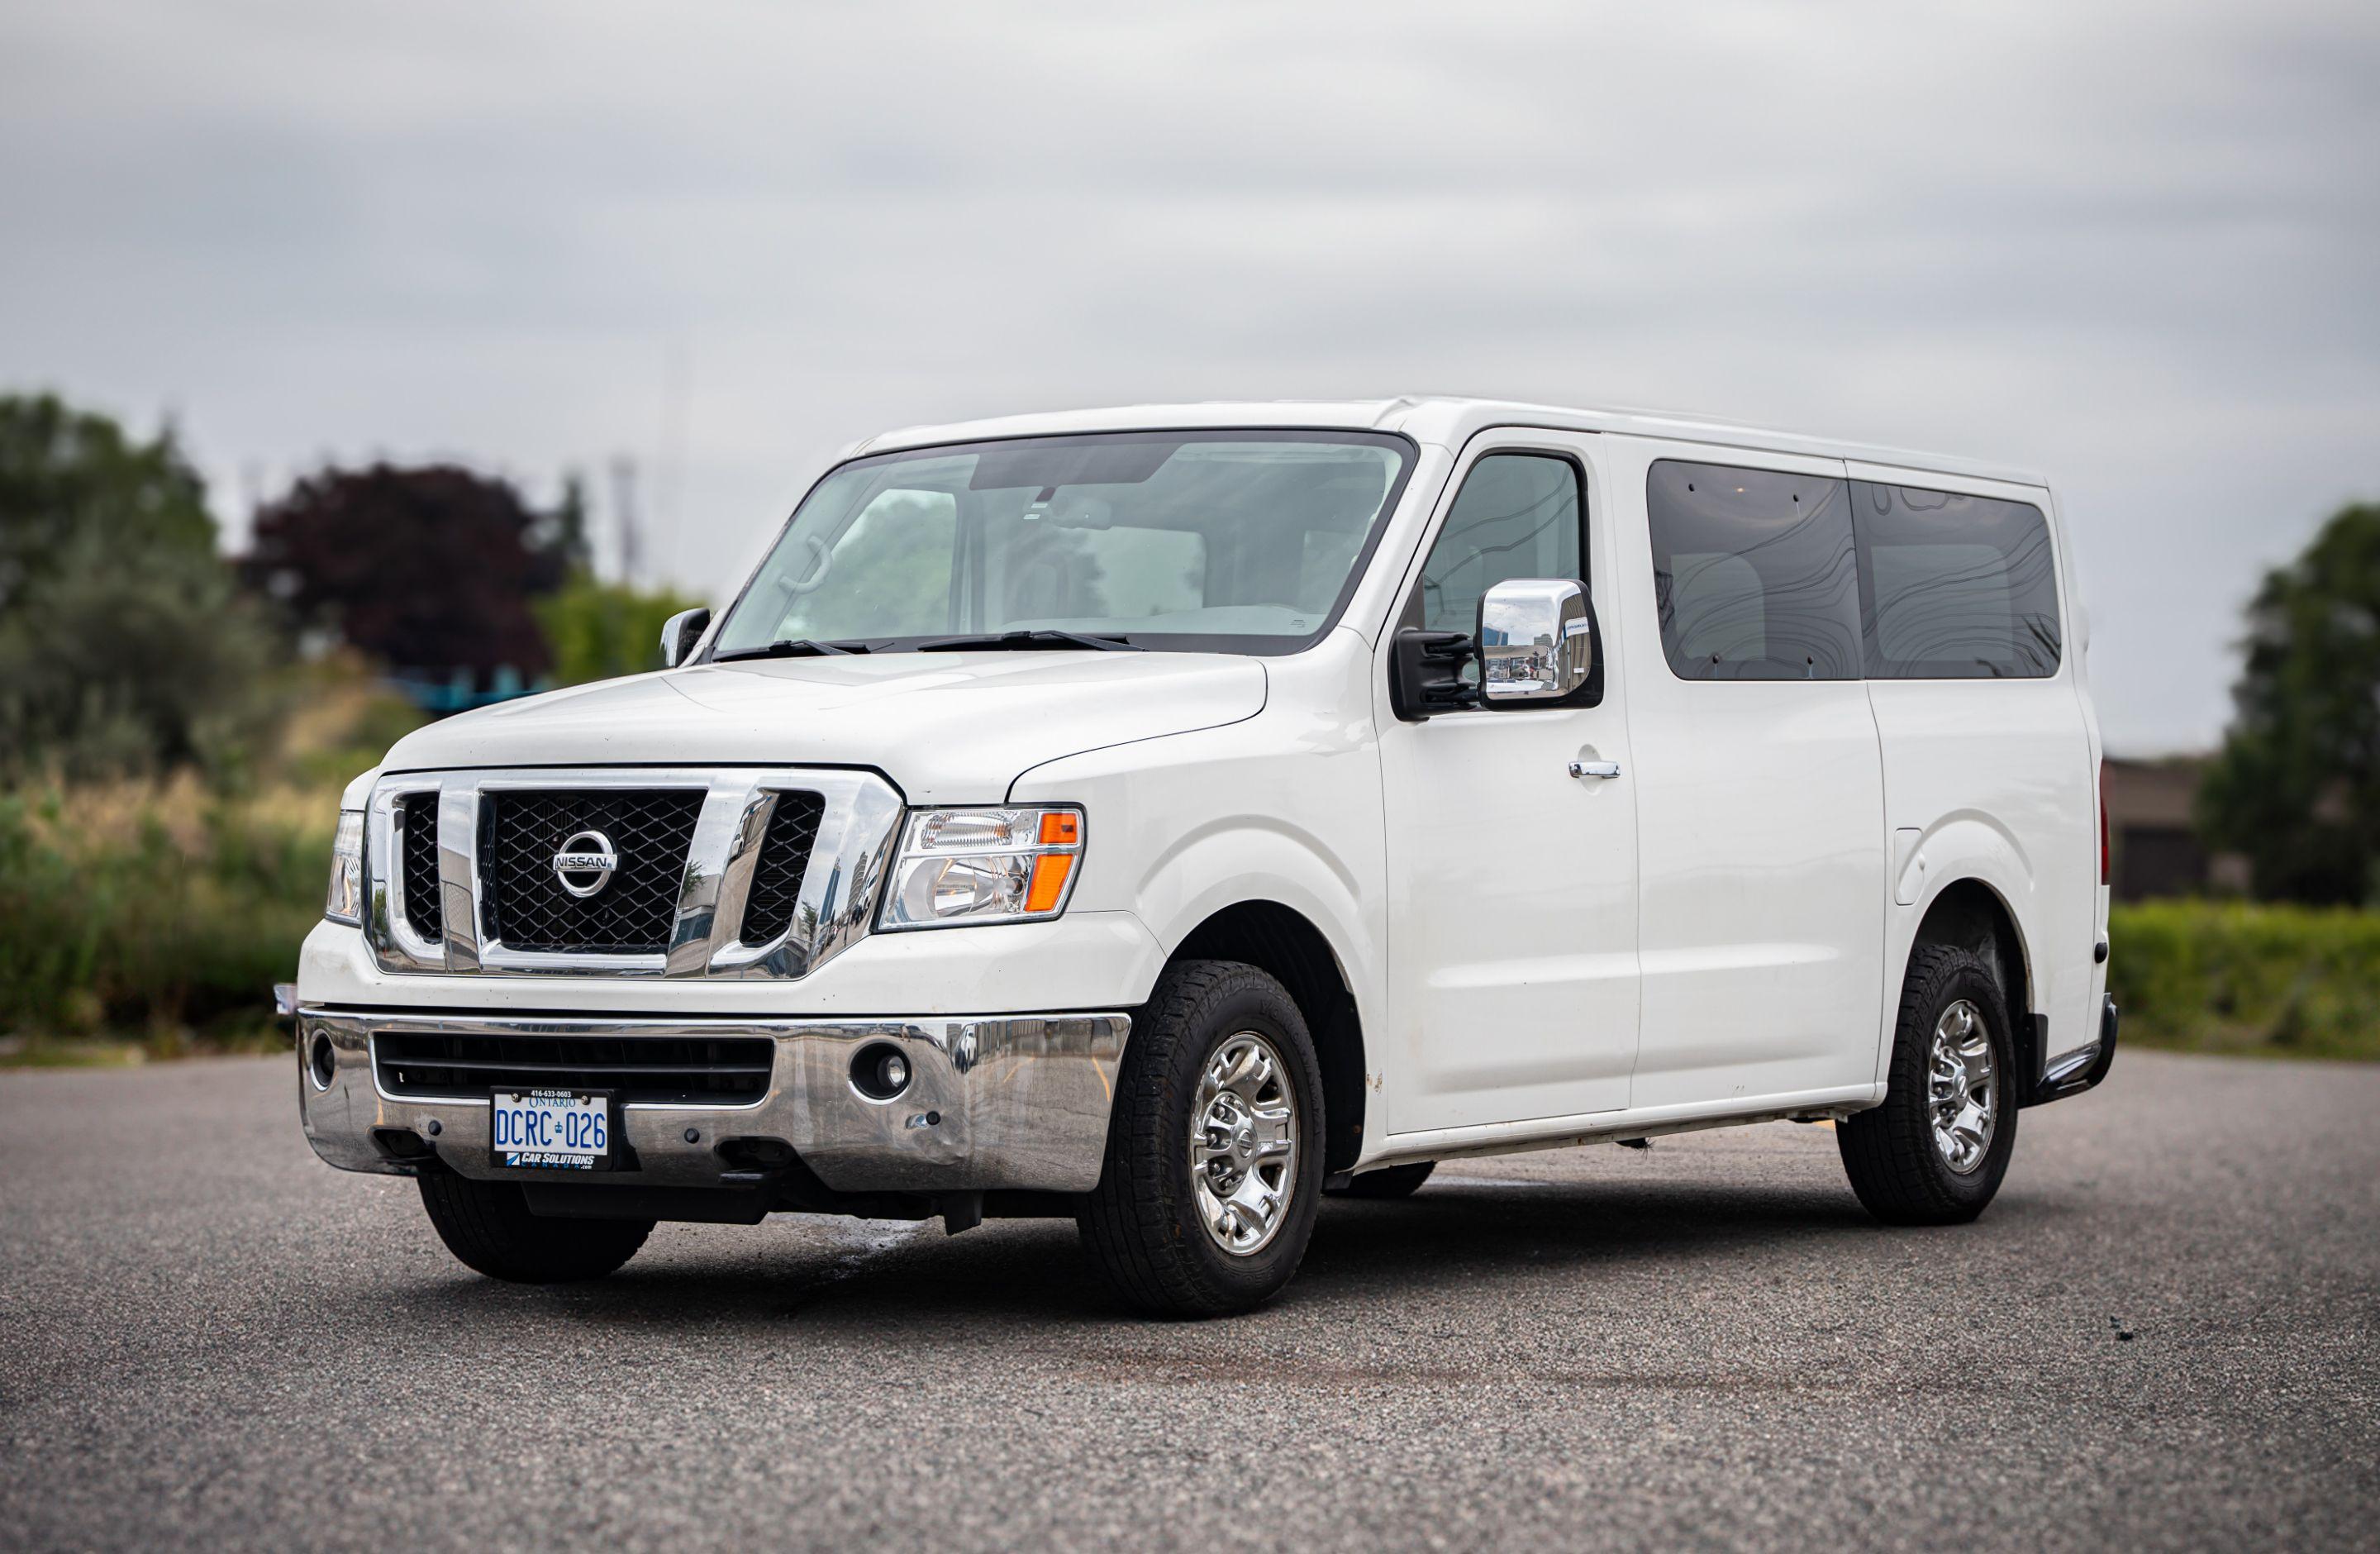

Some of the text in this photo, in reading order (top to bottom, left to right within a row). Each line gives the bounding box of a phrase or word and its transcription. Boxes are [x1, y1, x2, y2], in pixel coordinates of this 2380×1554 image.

[555, 856, 607, 868] NISSAN
[531, 1089, 572, 1098] 416-633-0603
[529, 1097, 576, 1108] ONTARIO
[496, 1109, 606, 1149] DCRC 026
[521, 1152, 595, 1166] CAR SOLUTIONS
